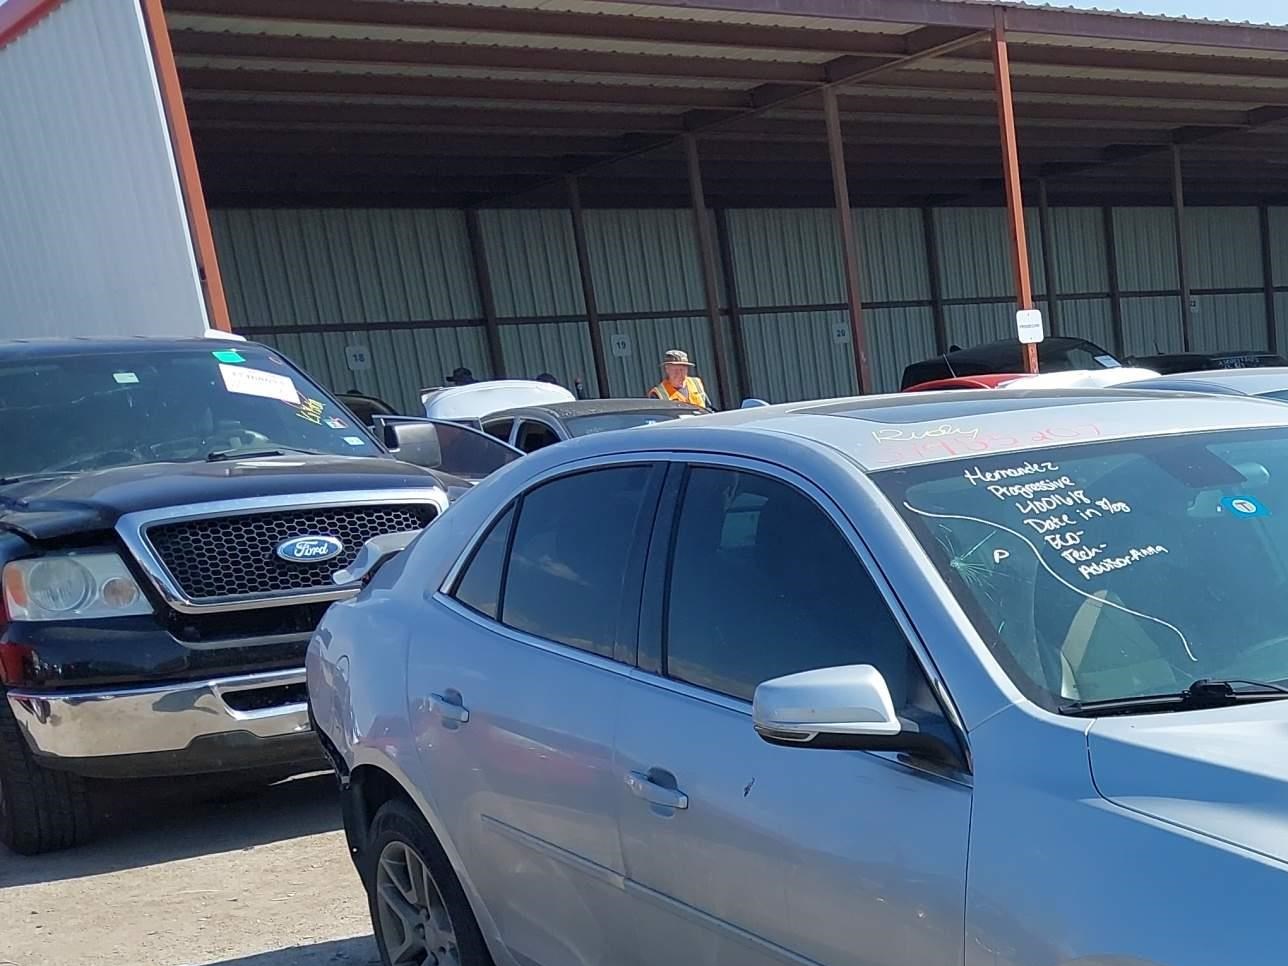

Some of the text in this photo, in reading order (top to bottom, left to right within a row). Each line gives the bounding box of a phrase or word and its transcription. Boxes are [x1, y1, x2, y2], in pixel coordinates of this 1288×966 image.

[616, 341, 626, 349] 19
[964, 462, 1059, 486] Hernandez
[987, 475, 1075, 500] Progressive
[1023, 513, 1077, 534] Date
[1076, 507, 1102, 521] in
[294, 541, 329, 557] Ford
